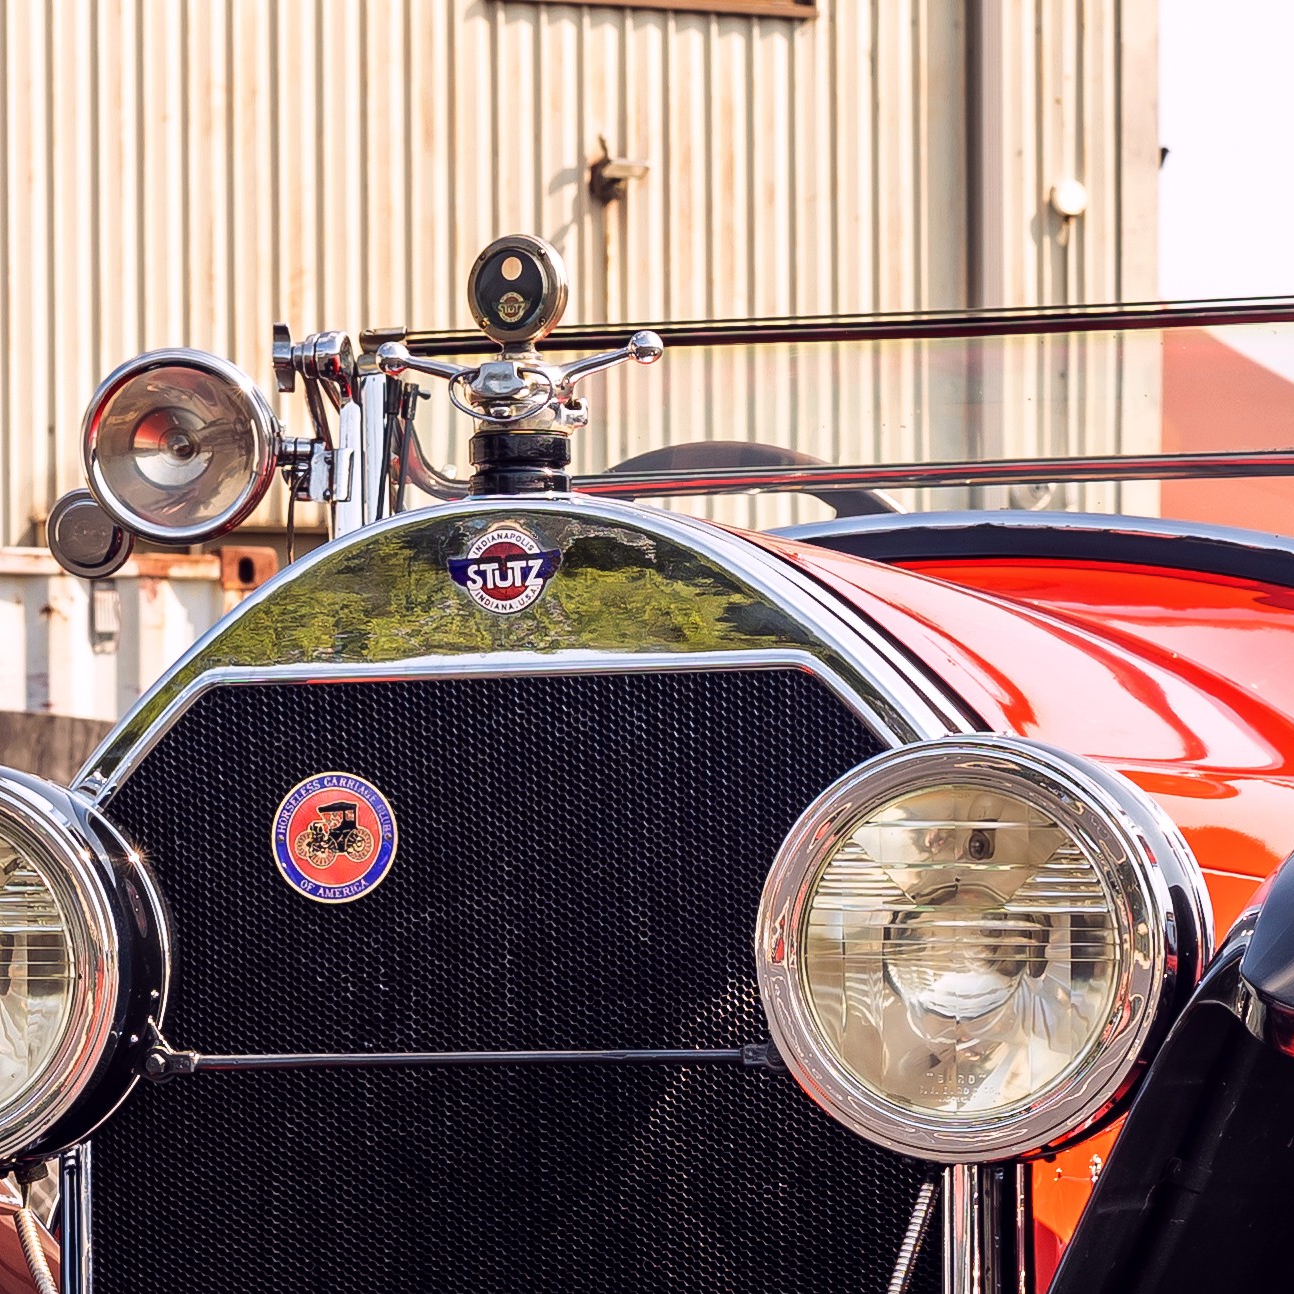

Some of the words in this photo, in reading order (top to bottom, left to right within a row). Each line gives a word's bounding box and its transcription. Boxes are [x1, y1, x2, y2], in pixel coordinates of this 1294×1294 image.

[473, 532, 535, 555] INDIANAPOLIS
[466, 559, 544, 591] STUTZ
[277, 780, 321, 834] HORSELESS
[323, 777, 377, 803] CARRIAGE
[376, 804, 393, 832] CLUB
[300, 879, 315, 892] OF
[317, 879, 370, 898] AMERICA
